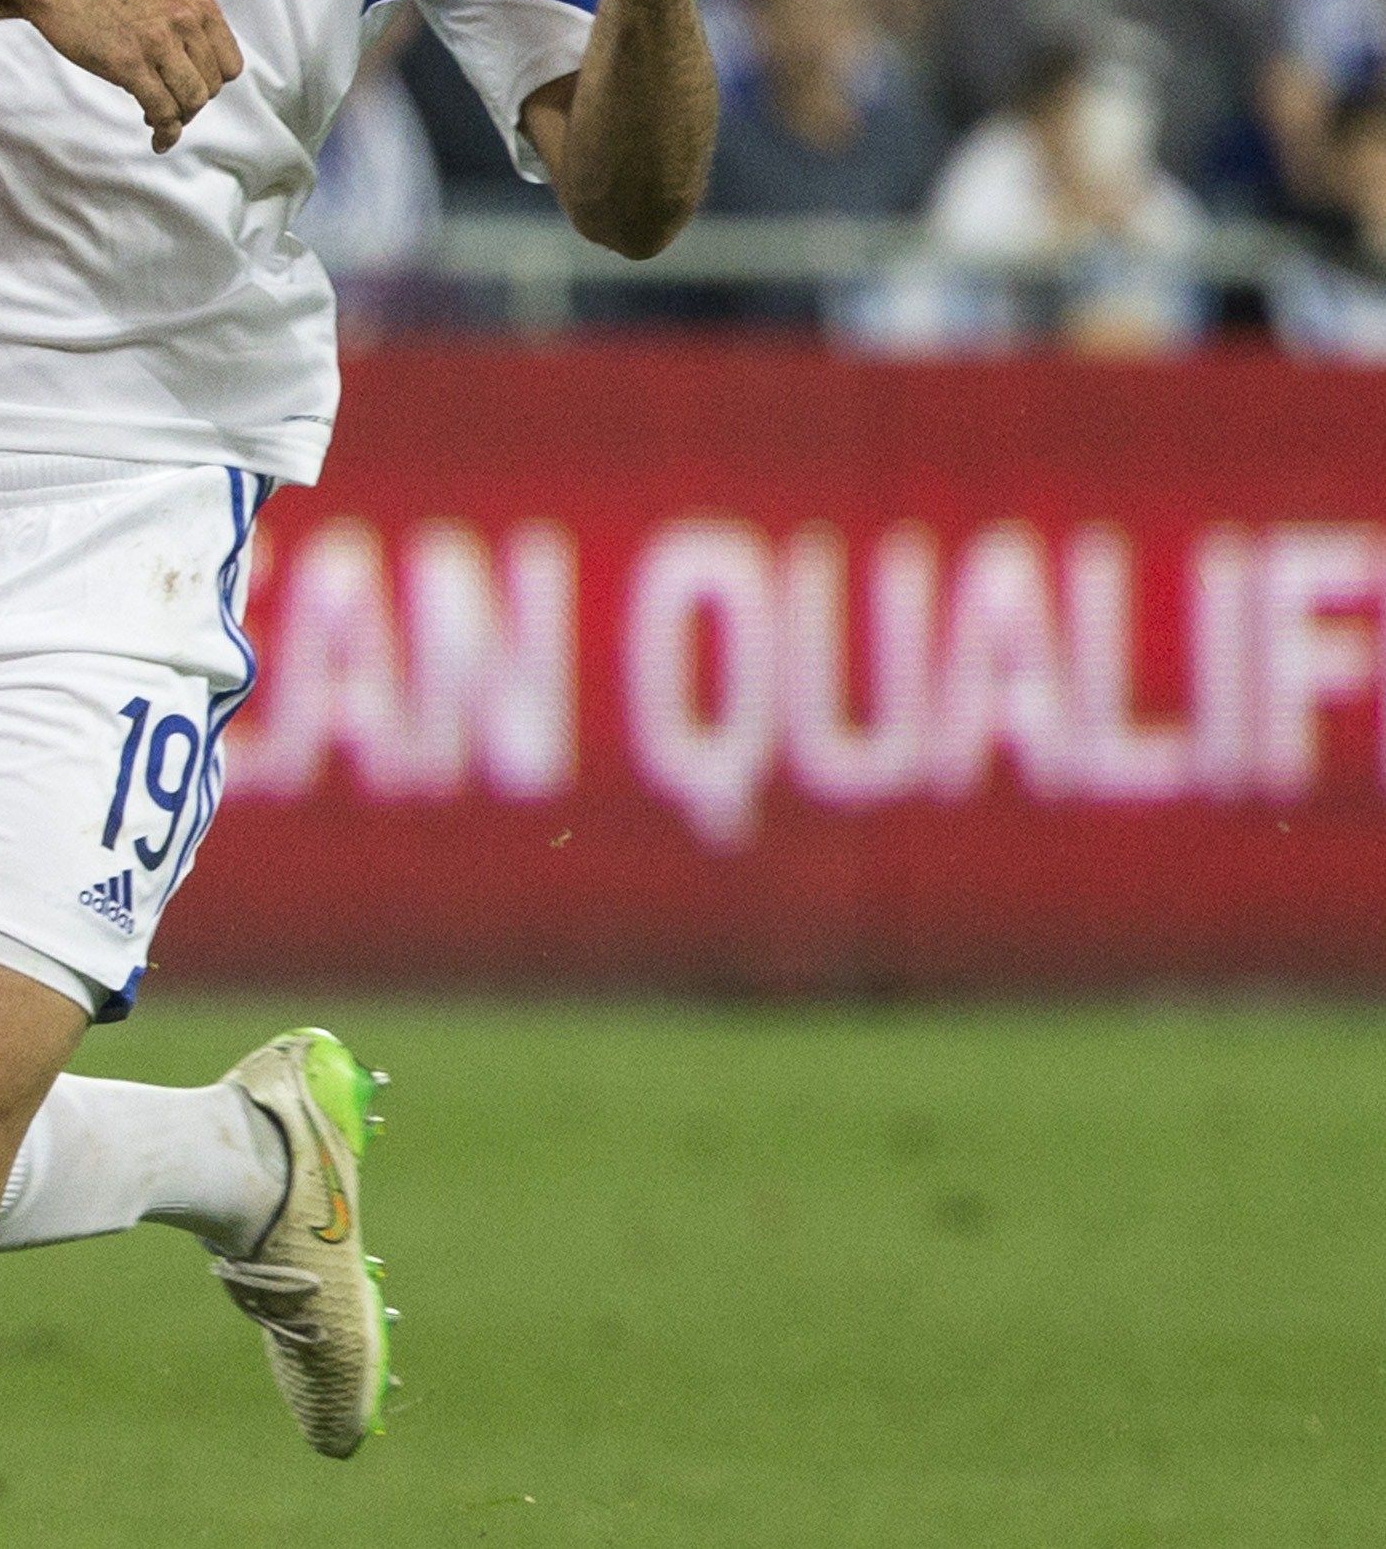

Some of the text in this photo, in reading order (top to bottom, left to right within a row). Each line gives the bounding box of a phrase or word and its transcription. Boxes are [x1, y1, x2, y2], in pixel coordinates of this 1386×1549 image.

[624, 511, 1386, 847] QUALIF
[100, 696, 200, 872] 19
[79, 889, 134, 936] adidas
